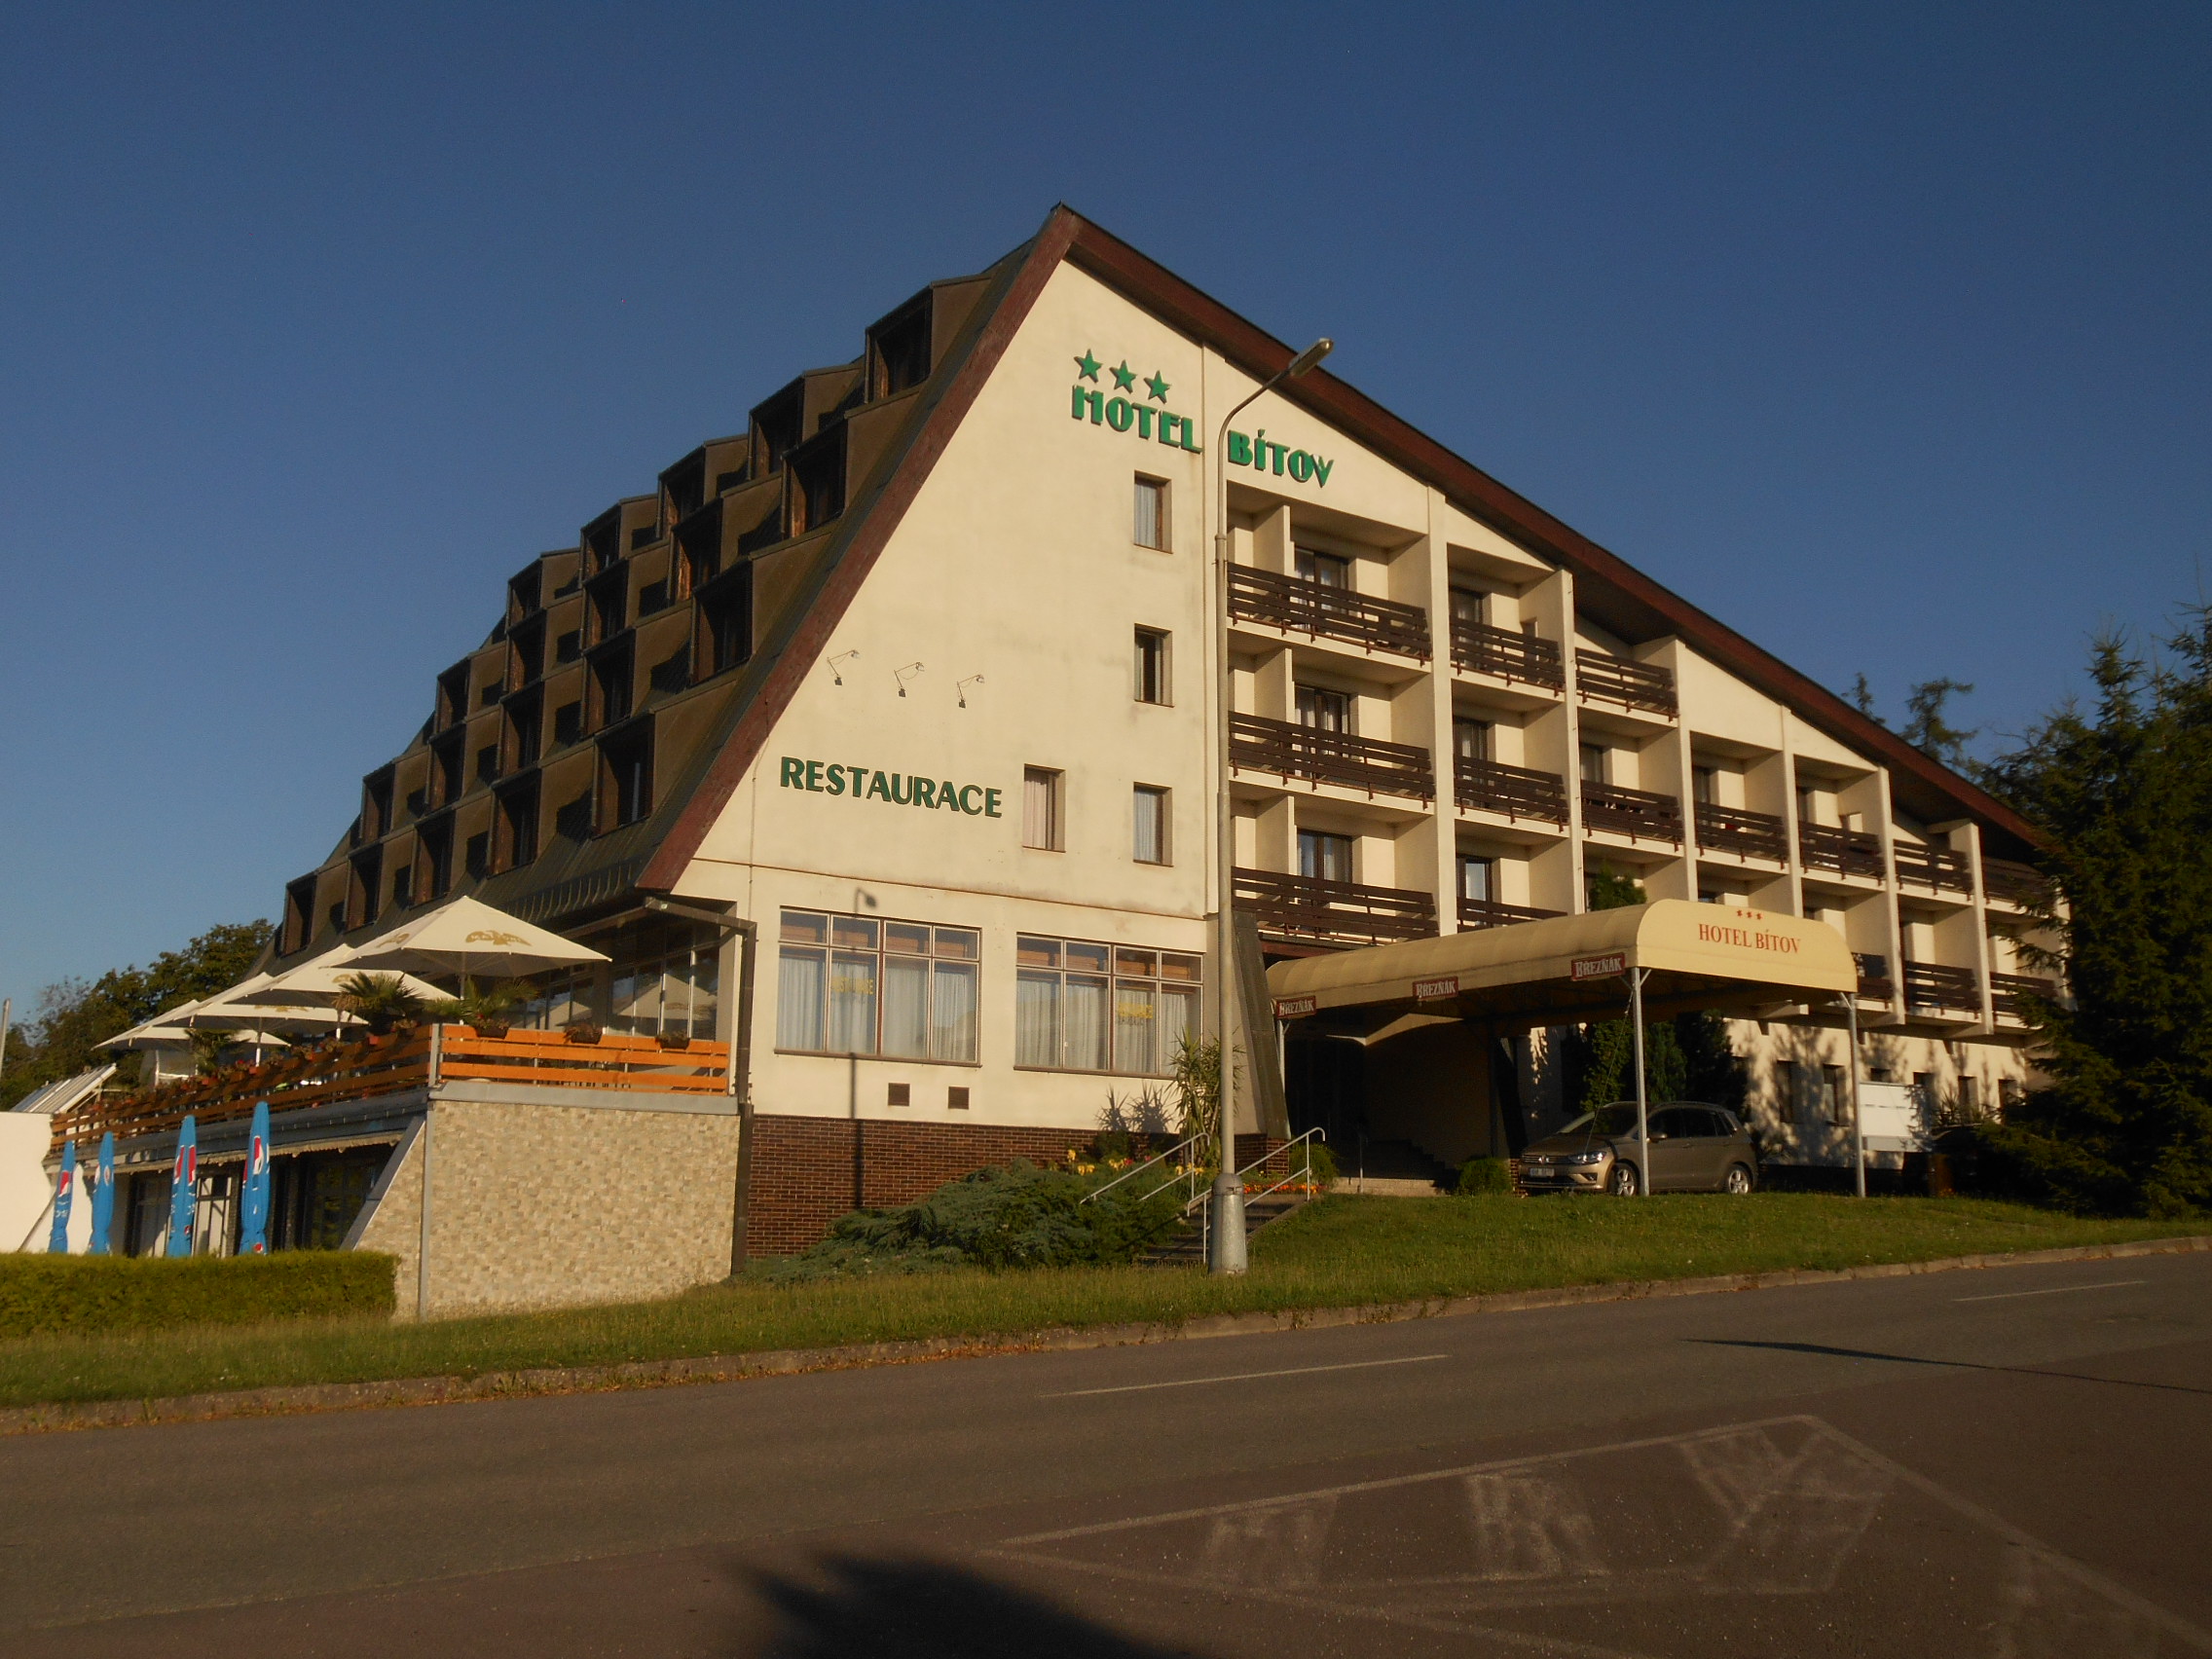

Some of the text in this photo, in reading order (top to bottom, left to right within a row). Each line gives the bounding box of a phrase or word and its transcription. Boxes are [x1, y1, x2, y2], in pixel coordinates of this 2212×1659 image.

[1072, 385, 1334, 488] HOTEL BÍTOV
[780, 756, 1002, 818] RESTAURACE
[1699, 923, 1801, 954] HOTEL BÍTOV
